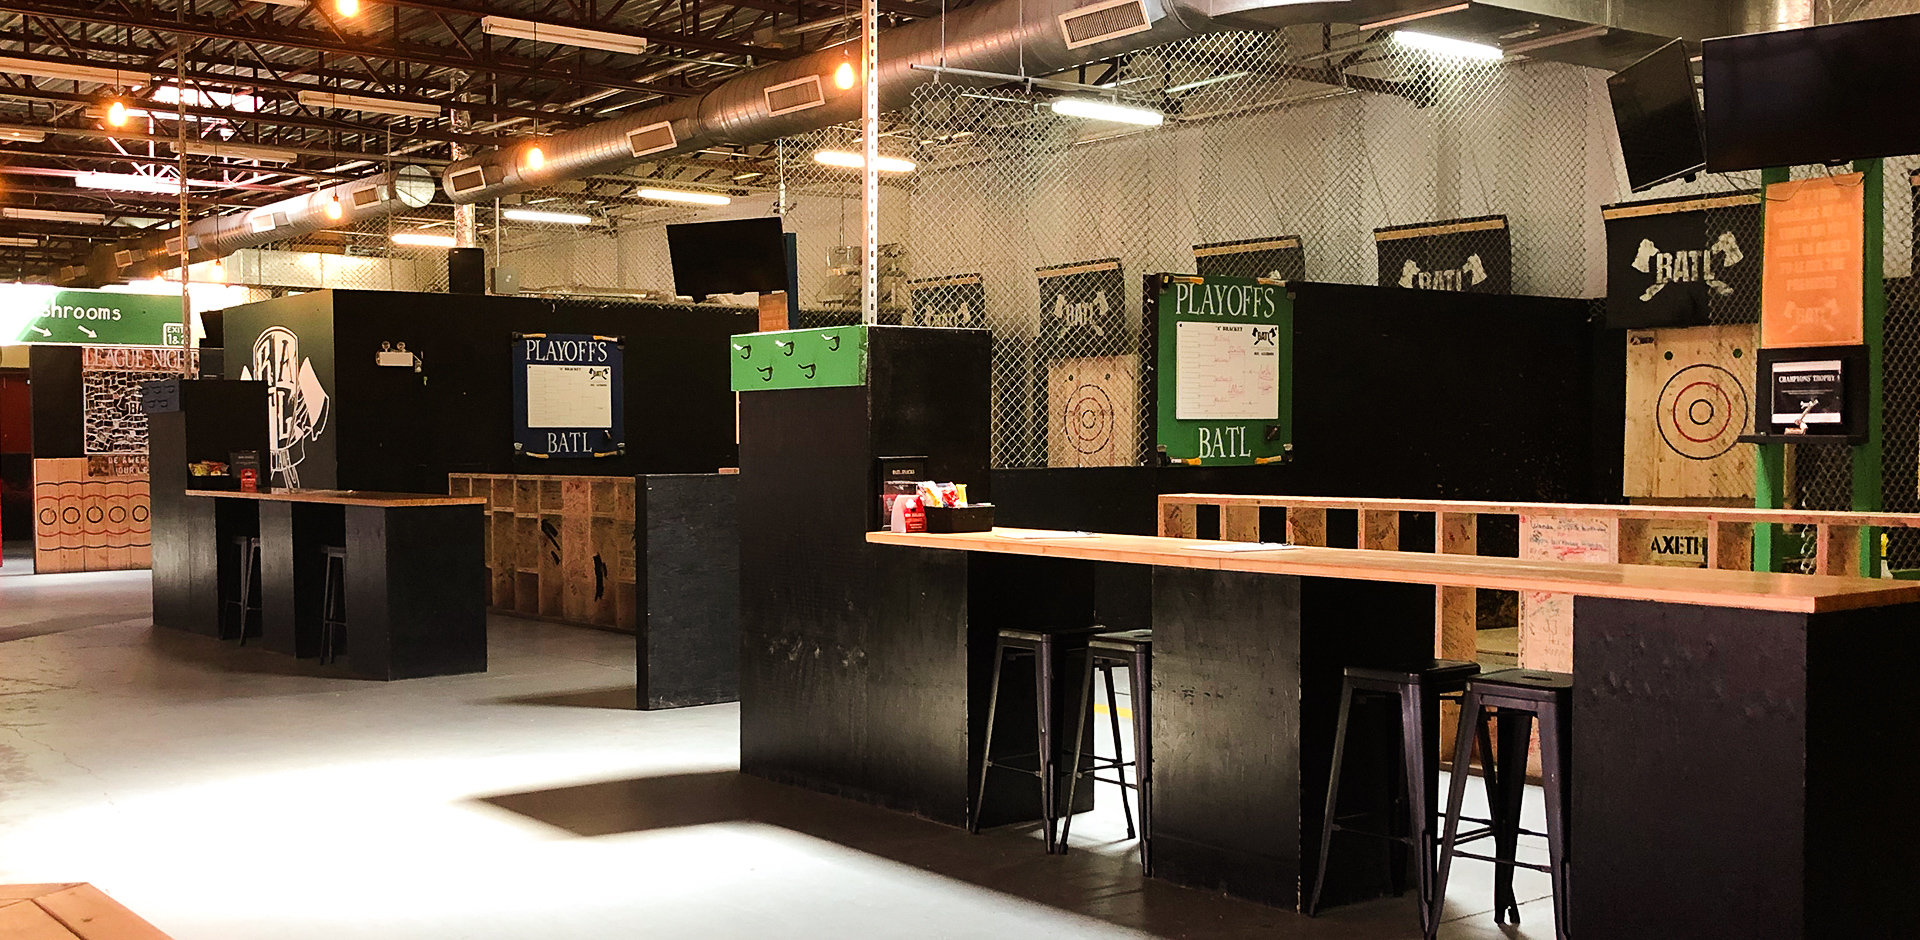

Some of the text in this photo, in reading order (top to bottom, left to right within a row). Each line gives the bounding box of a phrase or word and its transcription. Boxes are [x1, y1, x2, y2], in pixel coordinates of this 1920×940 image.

[1656, 250, 1716, 283] BATL
[1175, 283, 1276, 318] PLAYOFFS
[84, 348, 145, 368] LEAGUE
[526, 339, 608, 362] PLAYOFFS
[548, 432, 593, 454] BATL
[1199, 426, 1252, 458] BATL
